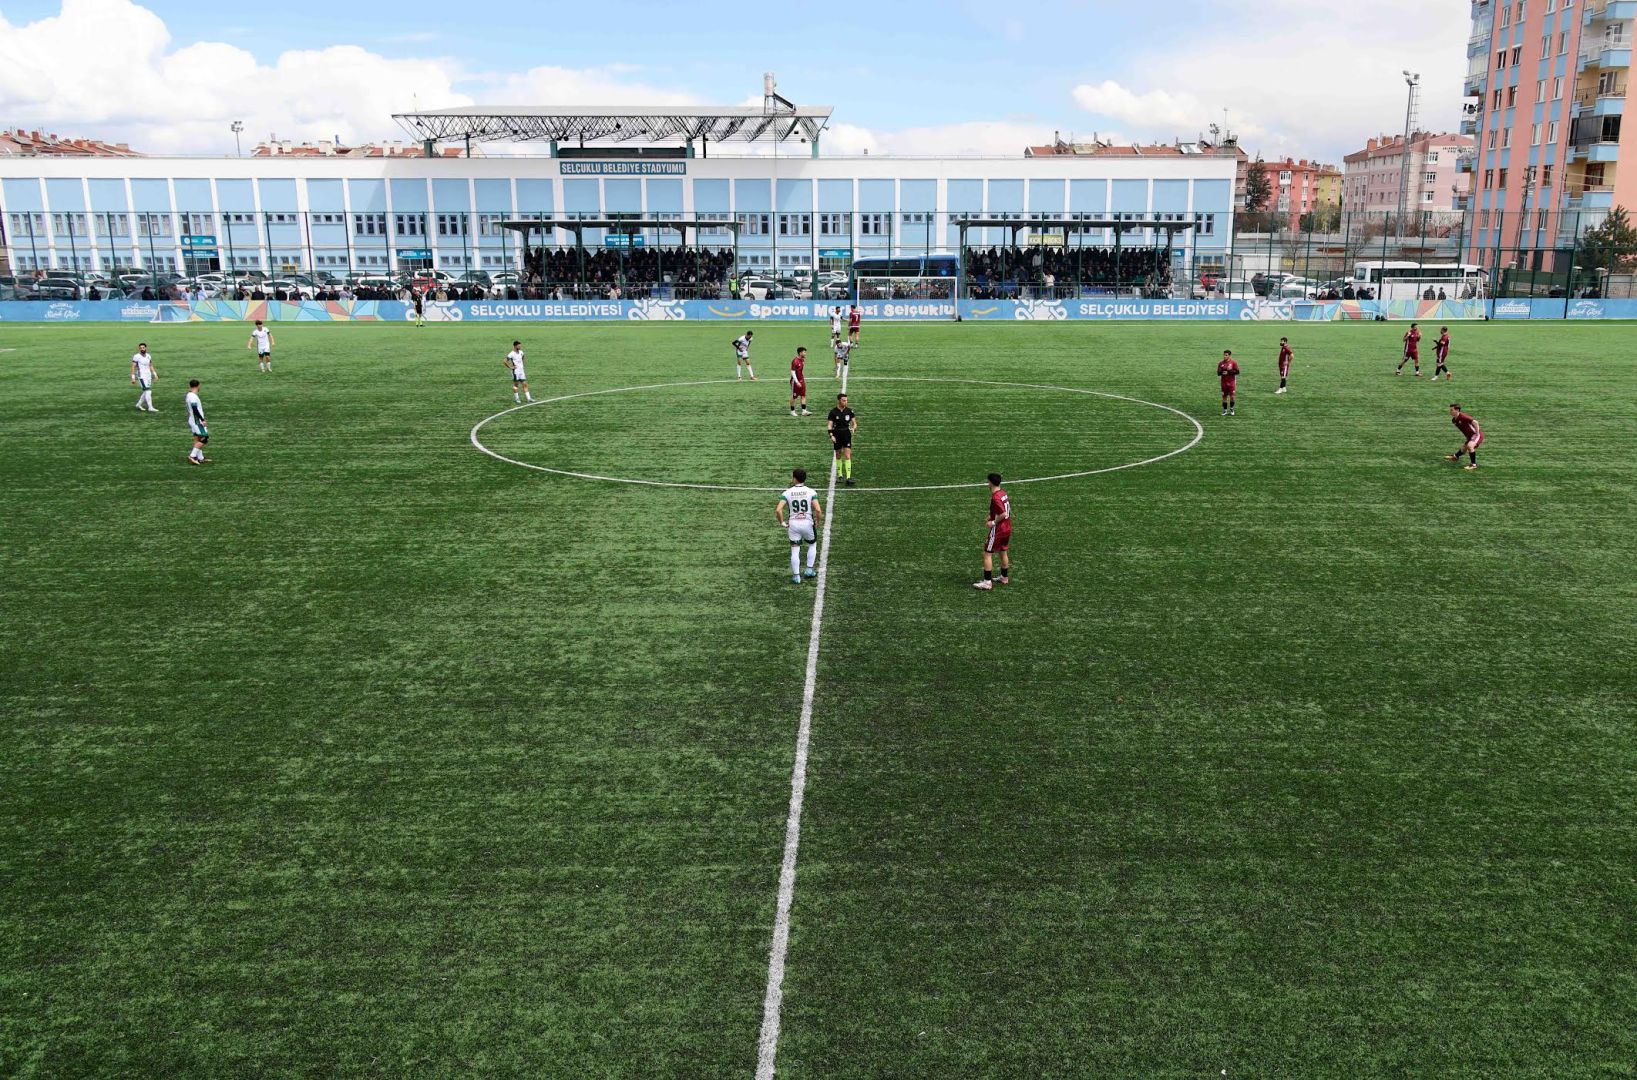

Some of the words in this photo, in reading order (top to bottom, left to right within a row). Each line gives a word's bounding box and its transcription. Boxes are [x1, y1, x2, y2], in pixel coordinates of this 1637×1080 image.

[641, 163, 685, 173] STADYUMU
[470, 304, 541, 318] SELÇUKLU
[544, 301, 622, 316] BELEDİYESİ
[750, 304, 809, 319] Sporun
[883, 303, 956, 317] Selçuklu
[1079, 303, 1149, 318] SELÇUKLU
[1153, 301, 1229, 315] BELEDİYESİ
[791, 499, 809, 514] 99
